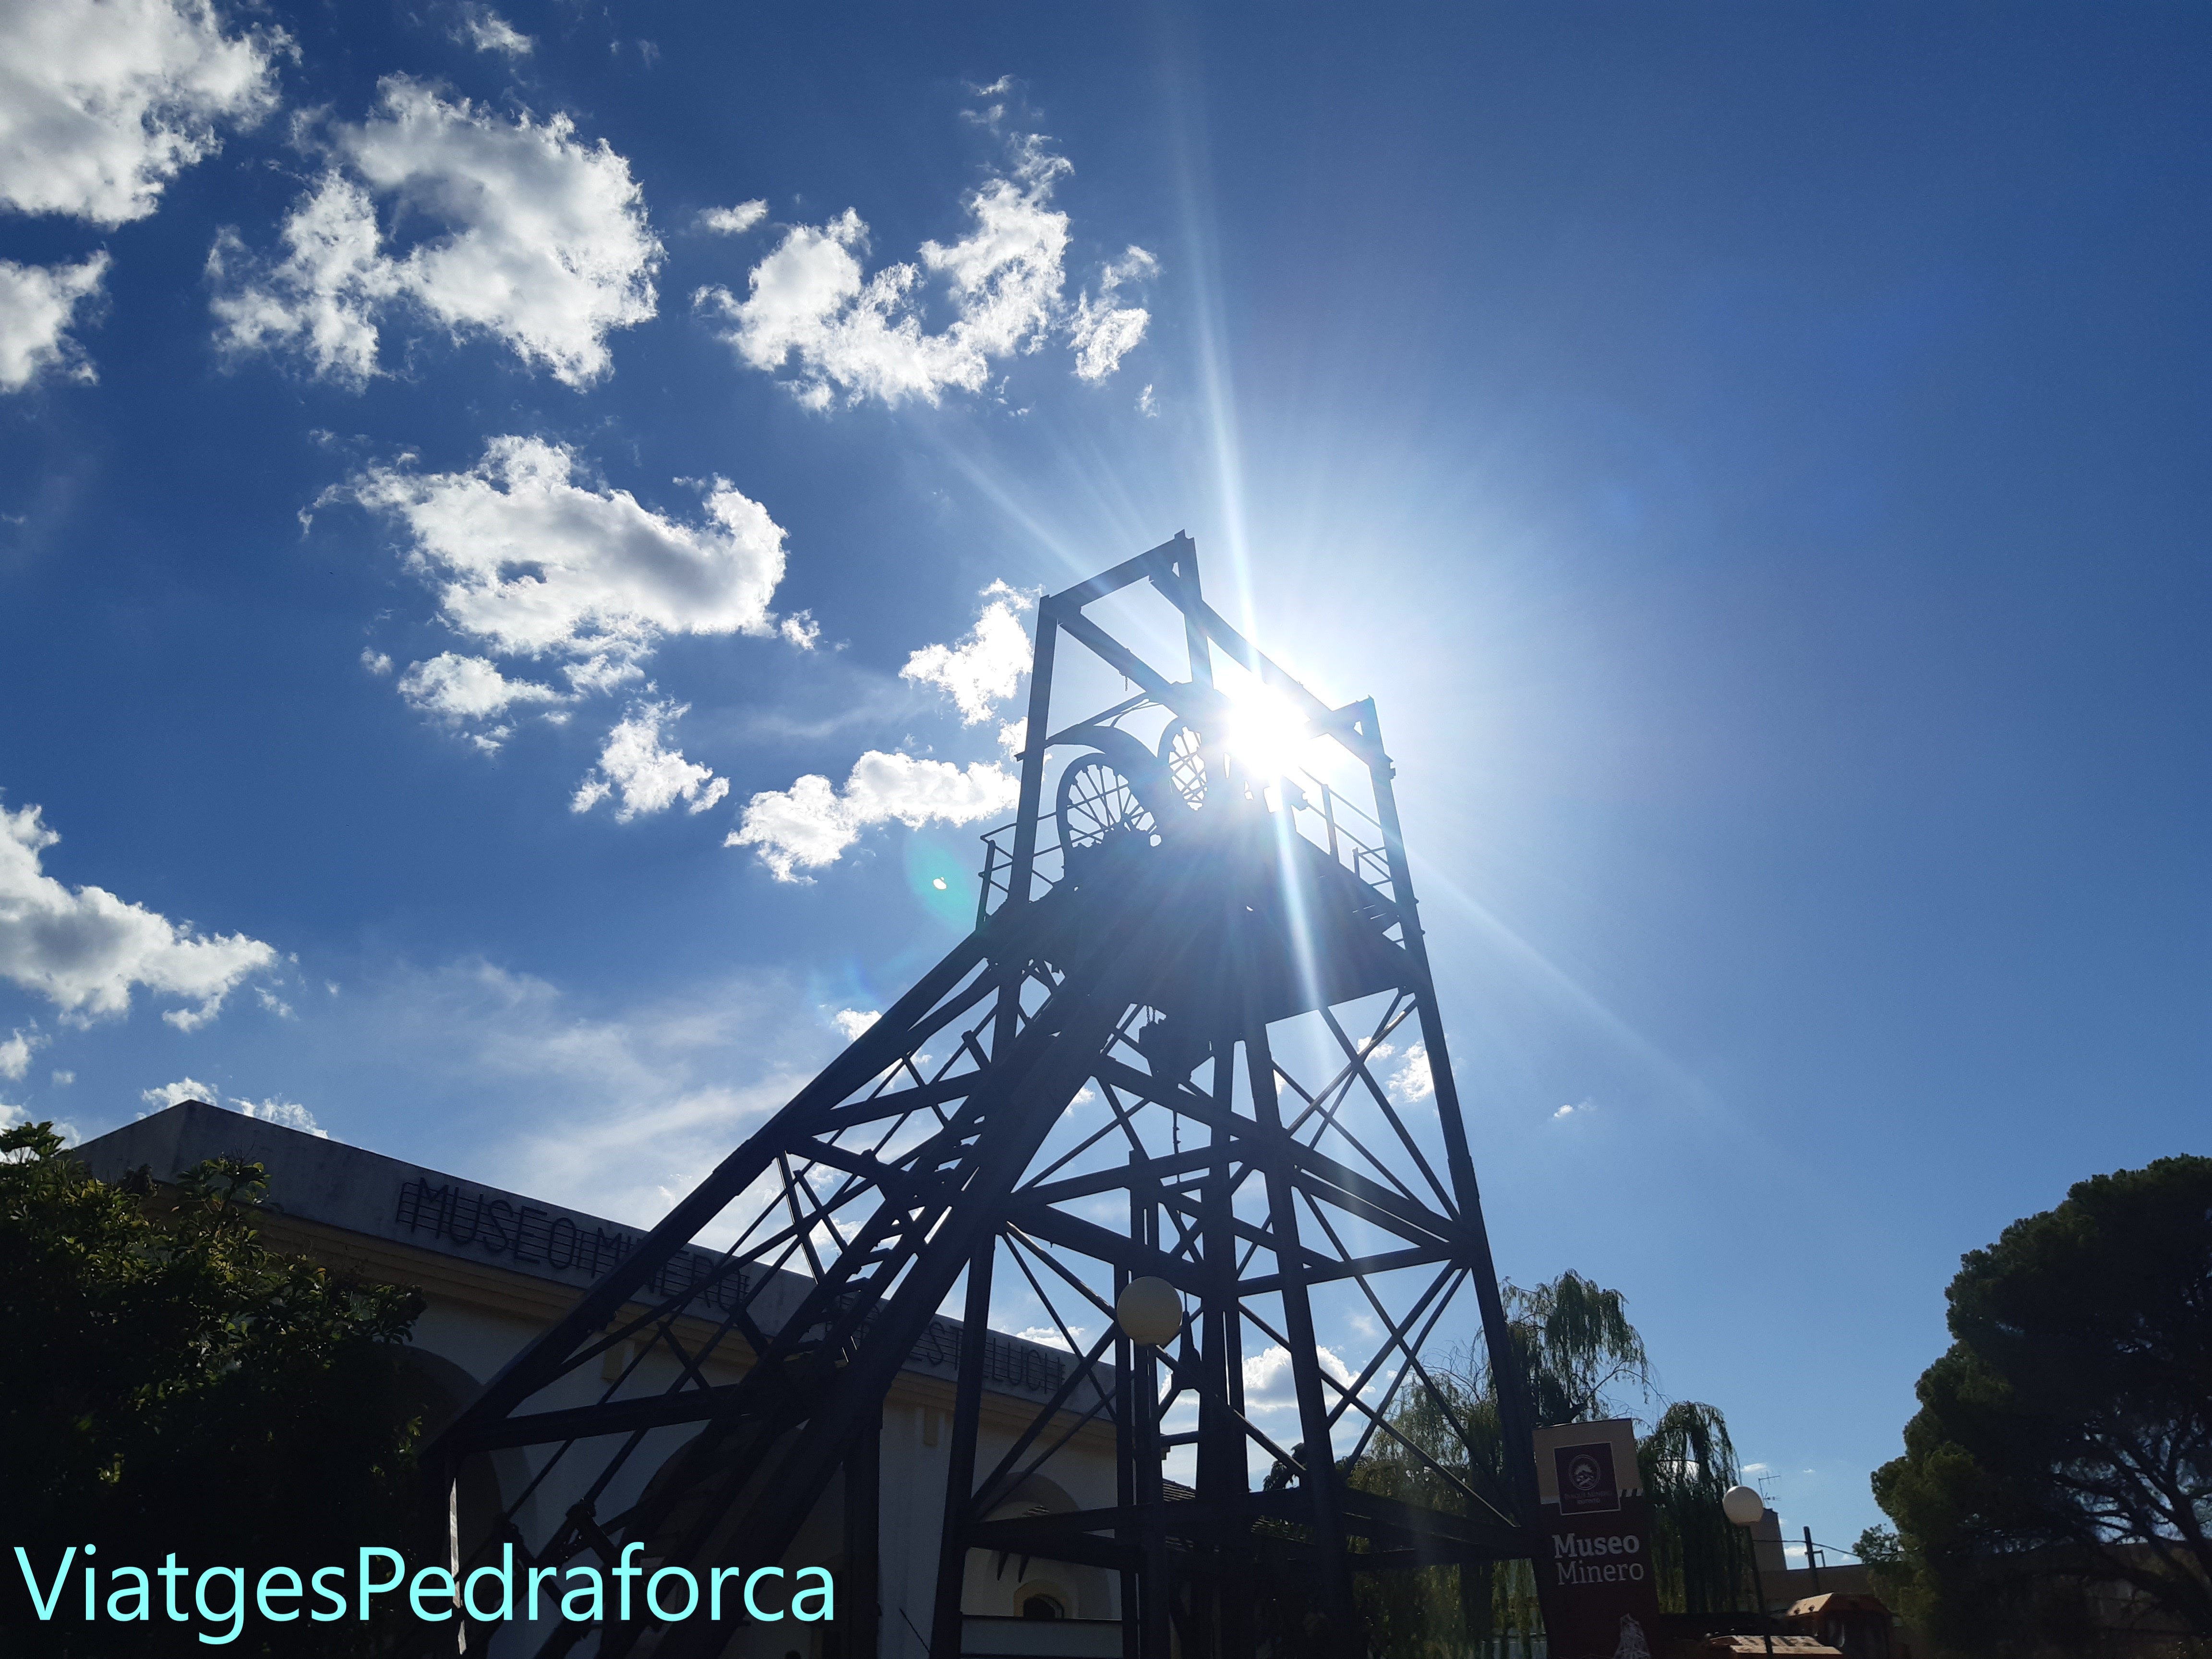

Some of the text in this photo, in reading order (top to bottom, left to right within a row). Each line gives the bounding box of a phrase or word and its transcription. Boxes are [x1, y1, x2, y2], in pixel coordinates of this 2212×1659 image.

[410, 1177, 577, 1270] MUSEO
[1551, 1533, 1639, 1559] Museo
[1556, 1560, 1644, 1585] Minero
